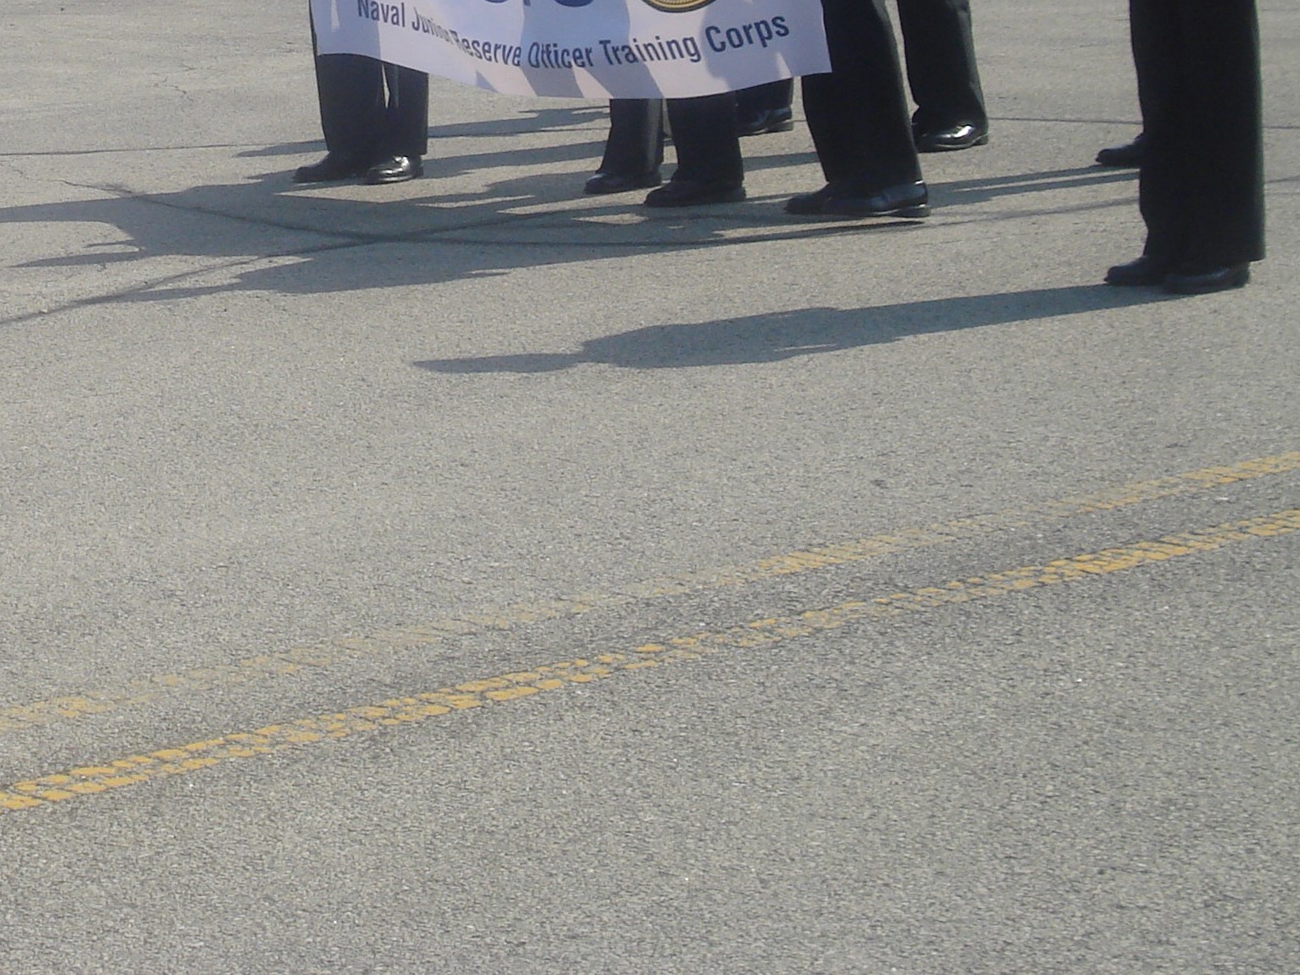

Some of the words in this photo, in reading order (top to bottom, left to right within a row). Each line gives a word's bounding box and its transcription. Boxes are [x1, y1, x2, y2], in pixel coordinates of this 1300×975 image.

[449, 29, 522, 67] Reserve
[528, 41, 594, 69] Officer
[599, 36, 702, 63] Training
[705, 15, 791, 54] Corps
